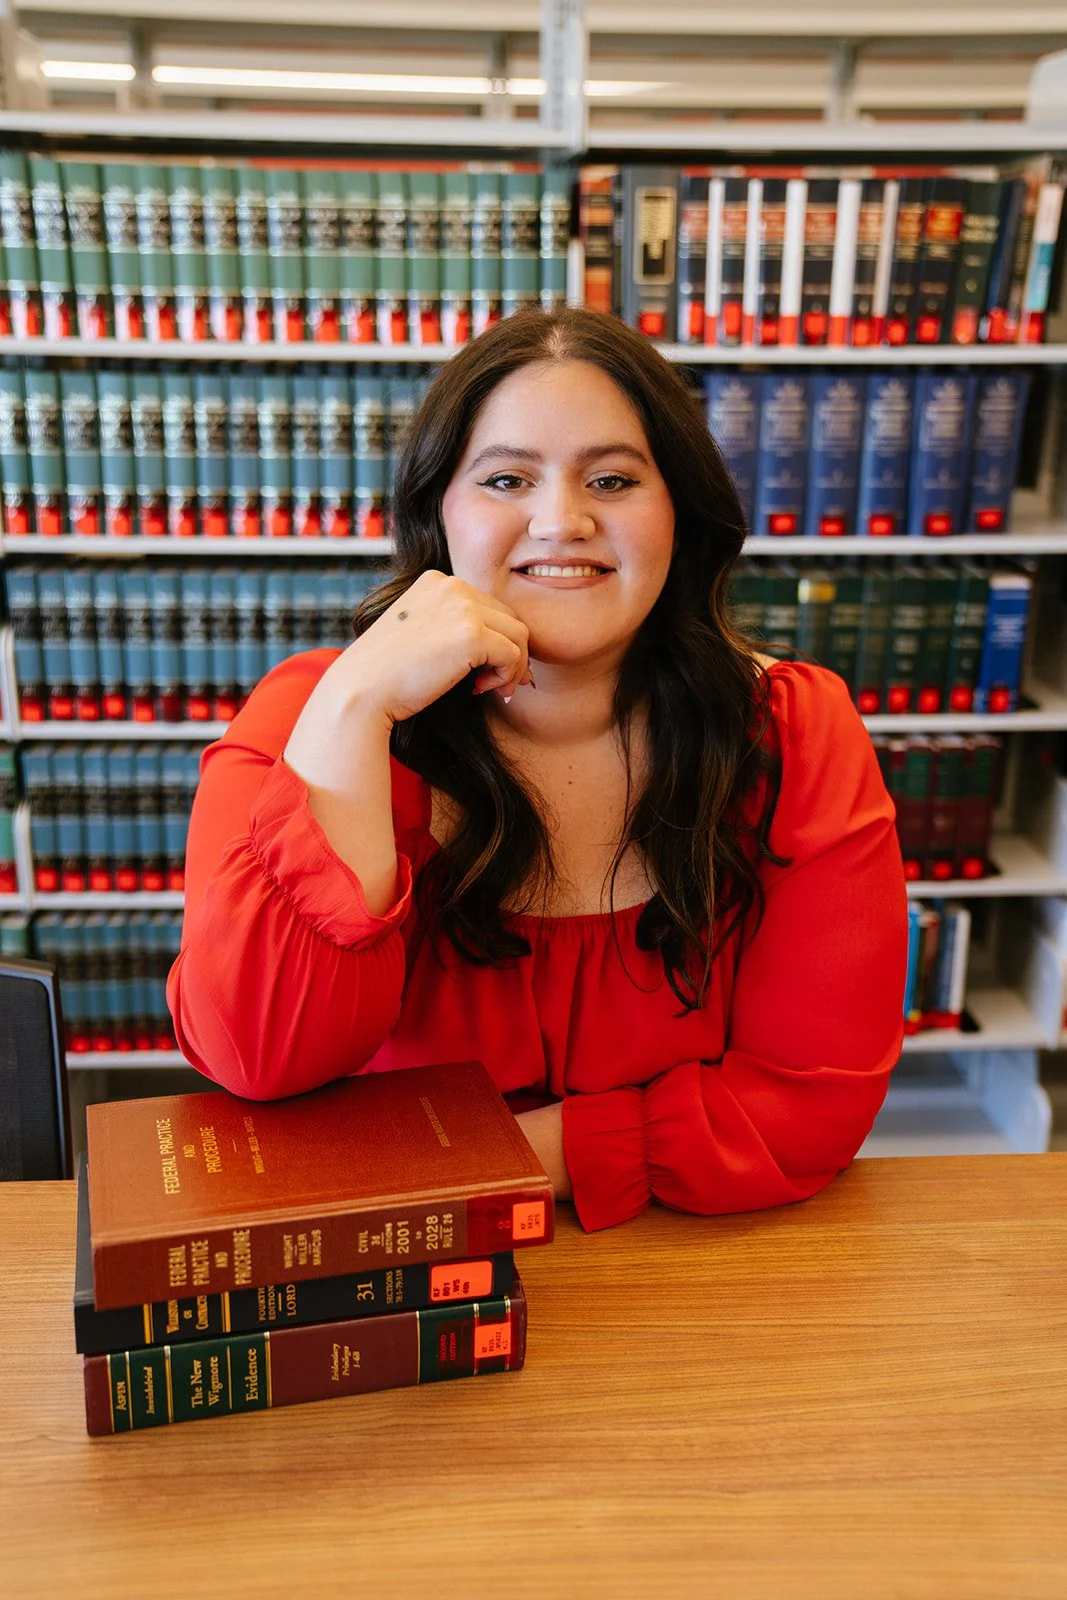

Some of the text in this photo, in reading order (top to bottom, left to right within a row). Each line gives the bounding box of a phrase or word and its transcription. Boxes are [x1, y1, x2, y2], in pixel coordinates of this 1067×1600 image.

[156, 1118, 181, 1194] FEDERAL PRACTICE
[183, 1144, 196, 1158] AND
[200, 1126, 222, 1173] PROCEDURE
[311, 1229, 322, 1266] MARCUS
[358, 1229, 369, 1253] CIVIL
[385, 1222, 393, 1254] SECTIONS
[396, 1220, 409, 1254] 2001
[426, 1215, 439, 1250] 2028
[442, 1213, 453, 1248] RULE 26
[168, 1244, 187, 1287] FEDERAL
[191, 1239, 210, 1286] PRACTICE
[214, 1251, 229, 1268] AND
[233, 1229, 252, 1285] PROCEDURE
[283, 1234, 293, 1268] WRIGHT
[297, 1233, 307, 1265] MILLER
[258, 1286, 266, 1321] FOURTH
[268, 1285, 276, 1320] EDITION
[286, 1284, 297, 1317] LORD
[357, 1280, 375, 1301] 31
[385, 1270, 393, 1304] SECTIONS
[433, 1287, 440, 1297] KF
[442, 1282, 450, 1297] 801
[190, 1359, 203, 1408] The New
[208, 1355, 223, 1406] Wigmore
[245, 1348, 258, 1401] Evidence
[116, 1381, 127, 1411] ASPEN
